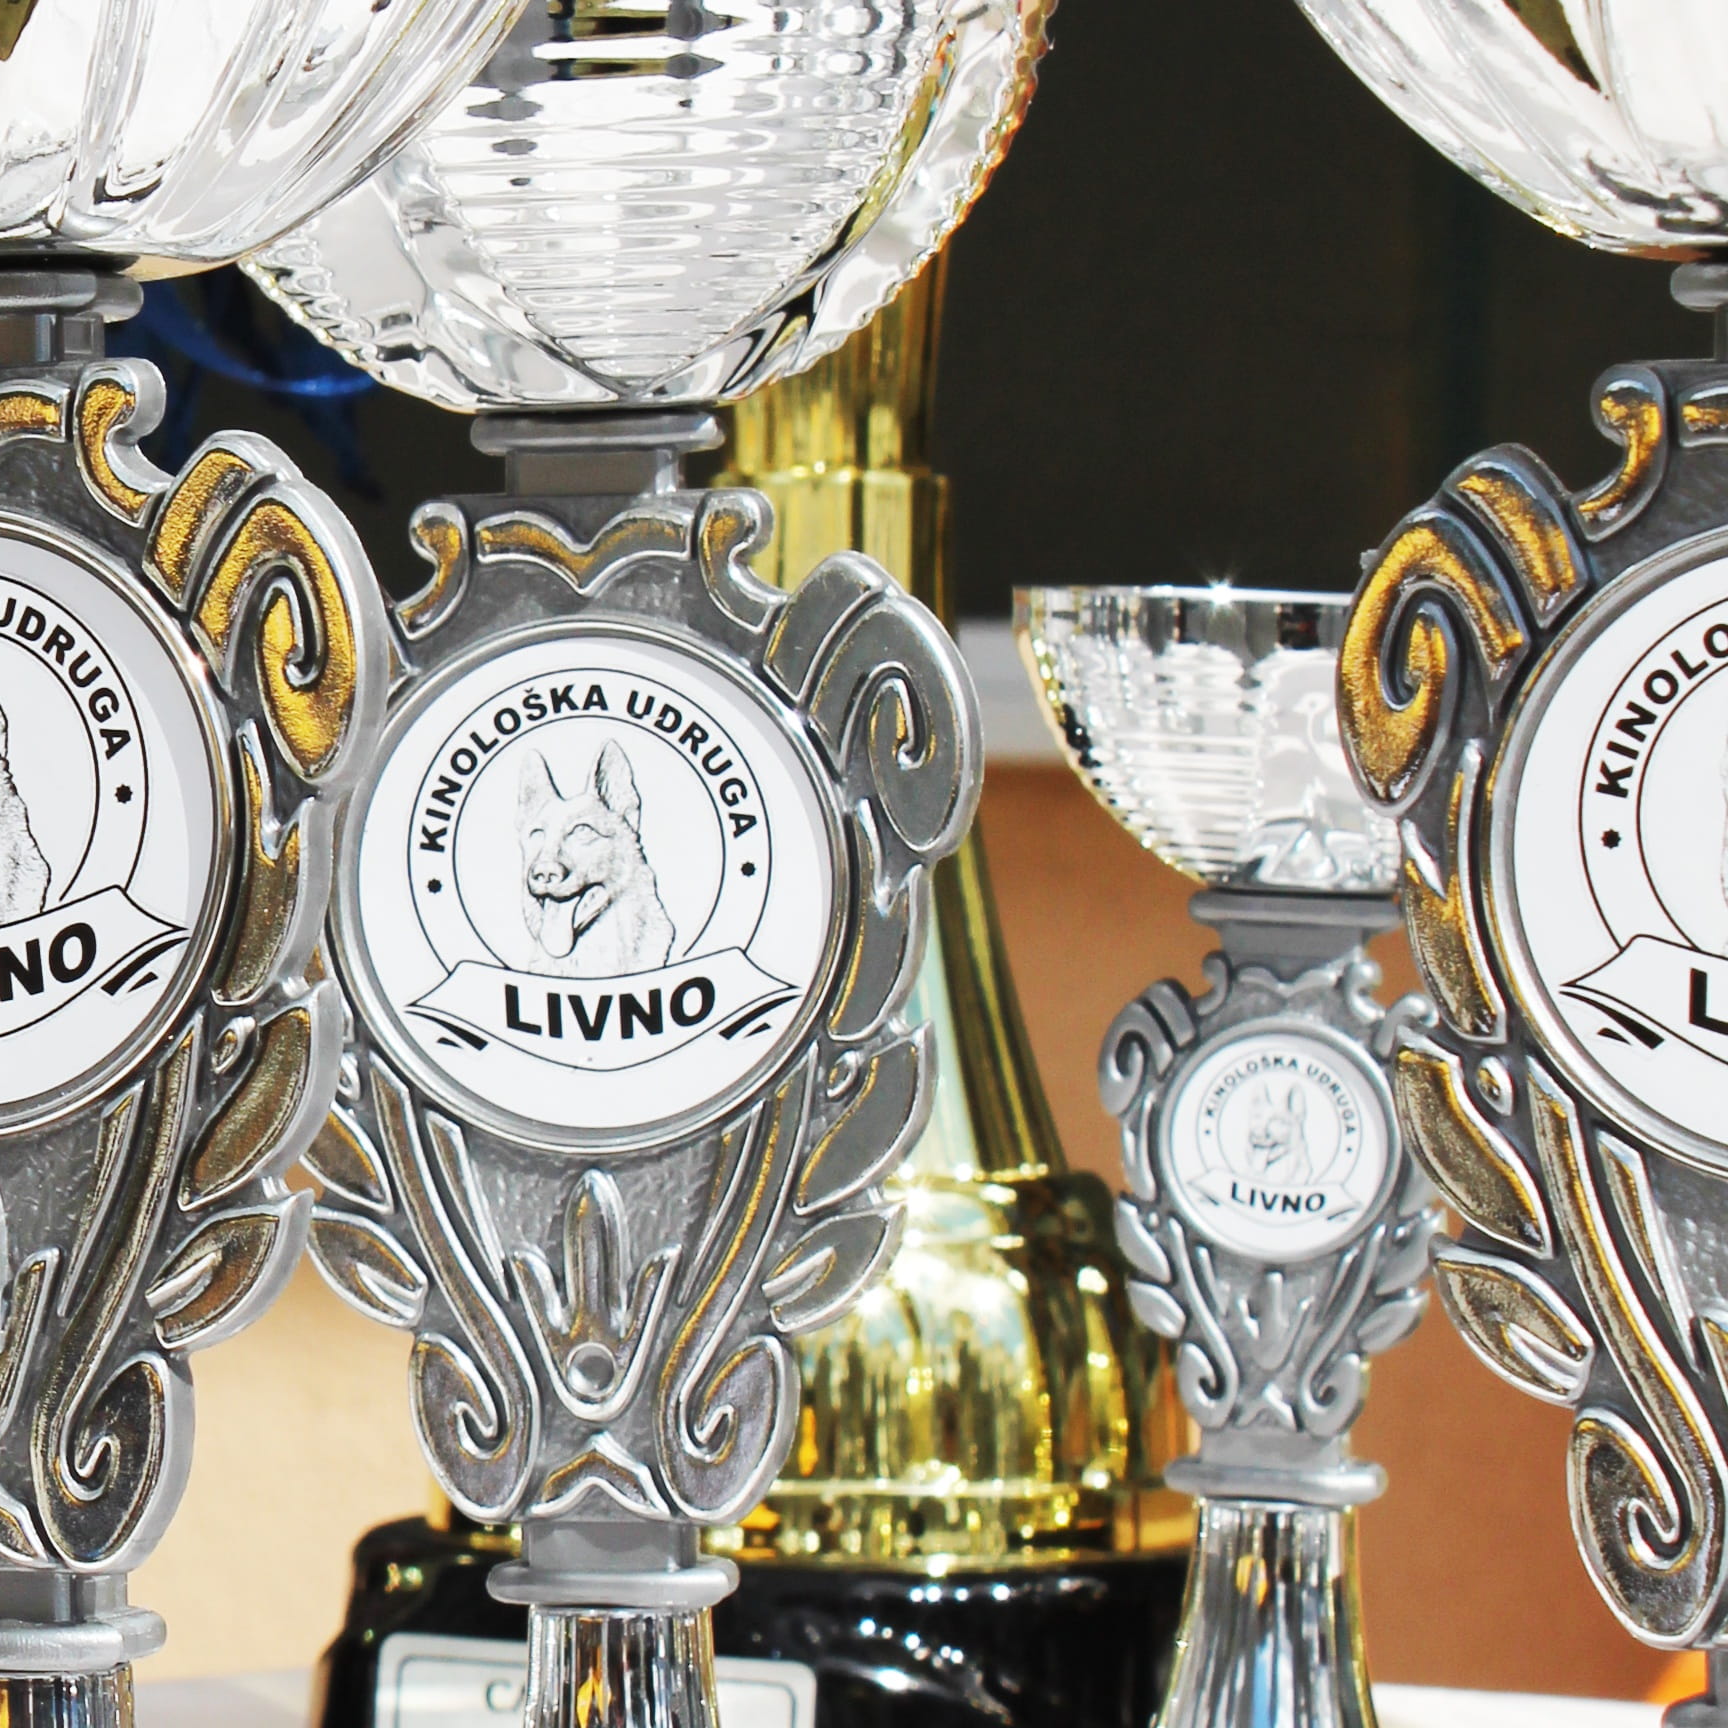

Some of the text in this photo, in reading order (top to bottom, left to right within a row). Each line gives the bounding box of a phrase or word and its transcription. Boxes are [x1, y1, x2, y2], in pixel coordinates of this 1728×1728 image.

[420, 683, 758, 853] KINOLOŠKA UDRUGA
[504, 976, 716, 1041] LIVNO
[1307, 1064, 1355, 1135] UDRUGA
[1231, 1181, 1326, 1213] LIVNO
